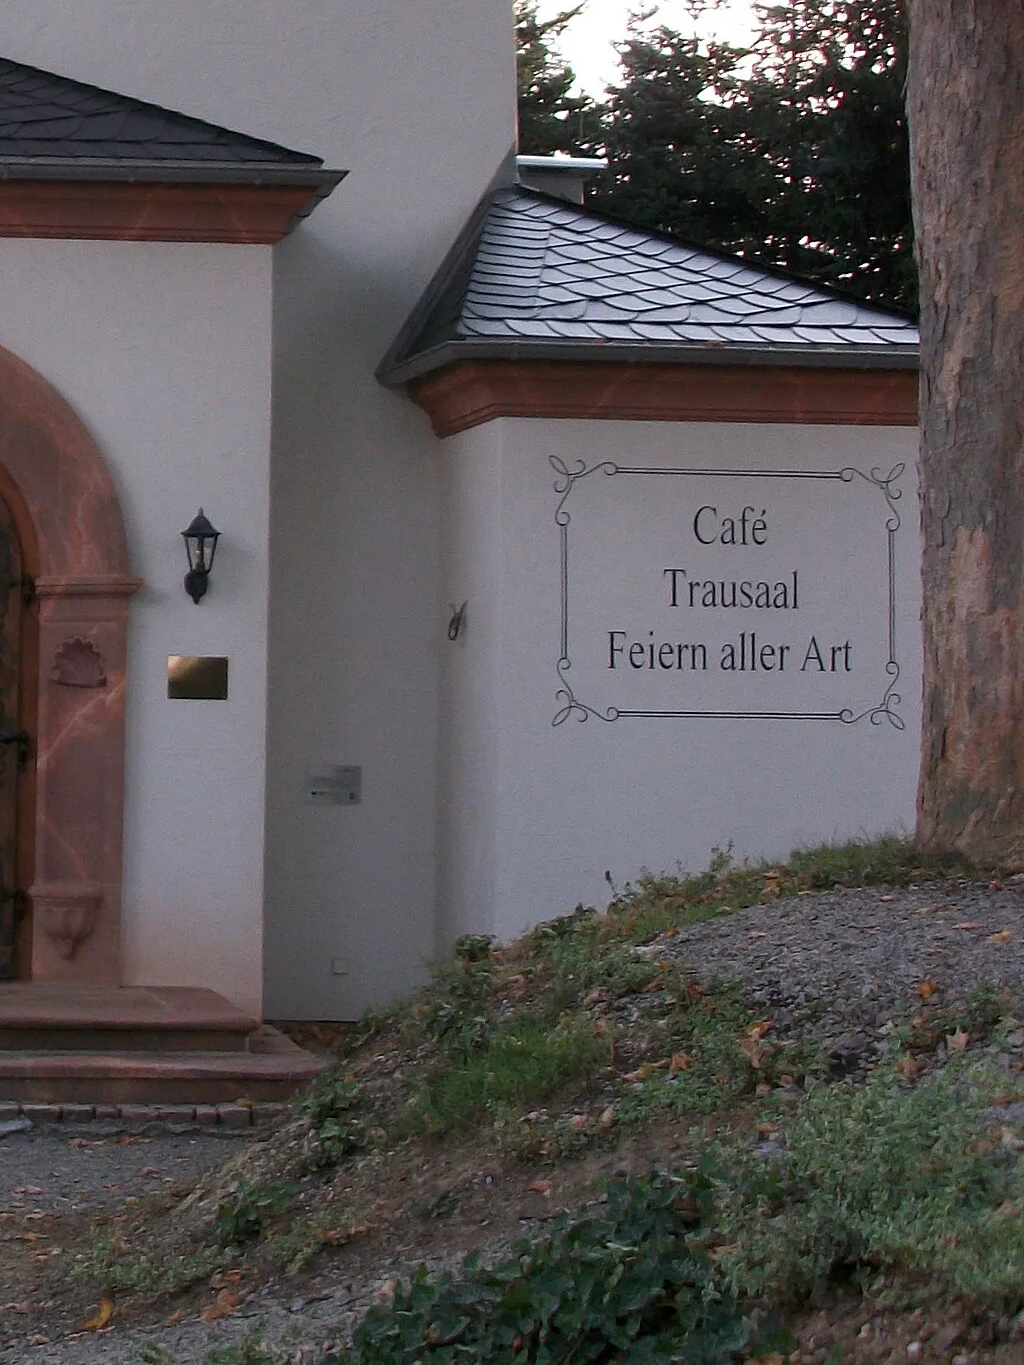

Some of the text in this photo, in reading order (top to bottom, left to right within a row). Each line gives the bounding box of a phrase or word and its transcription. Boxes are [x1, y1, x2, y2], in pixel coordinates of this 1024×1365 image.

[692, 505, 768, 546] Café
[664, 568, 800, 610] Trausaal
[607, 630, 853, 672] Feiern aller Art
